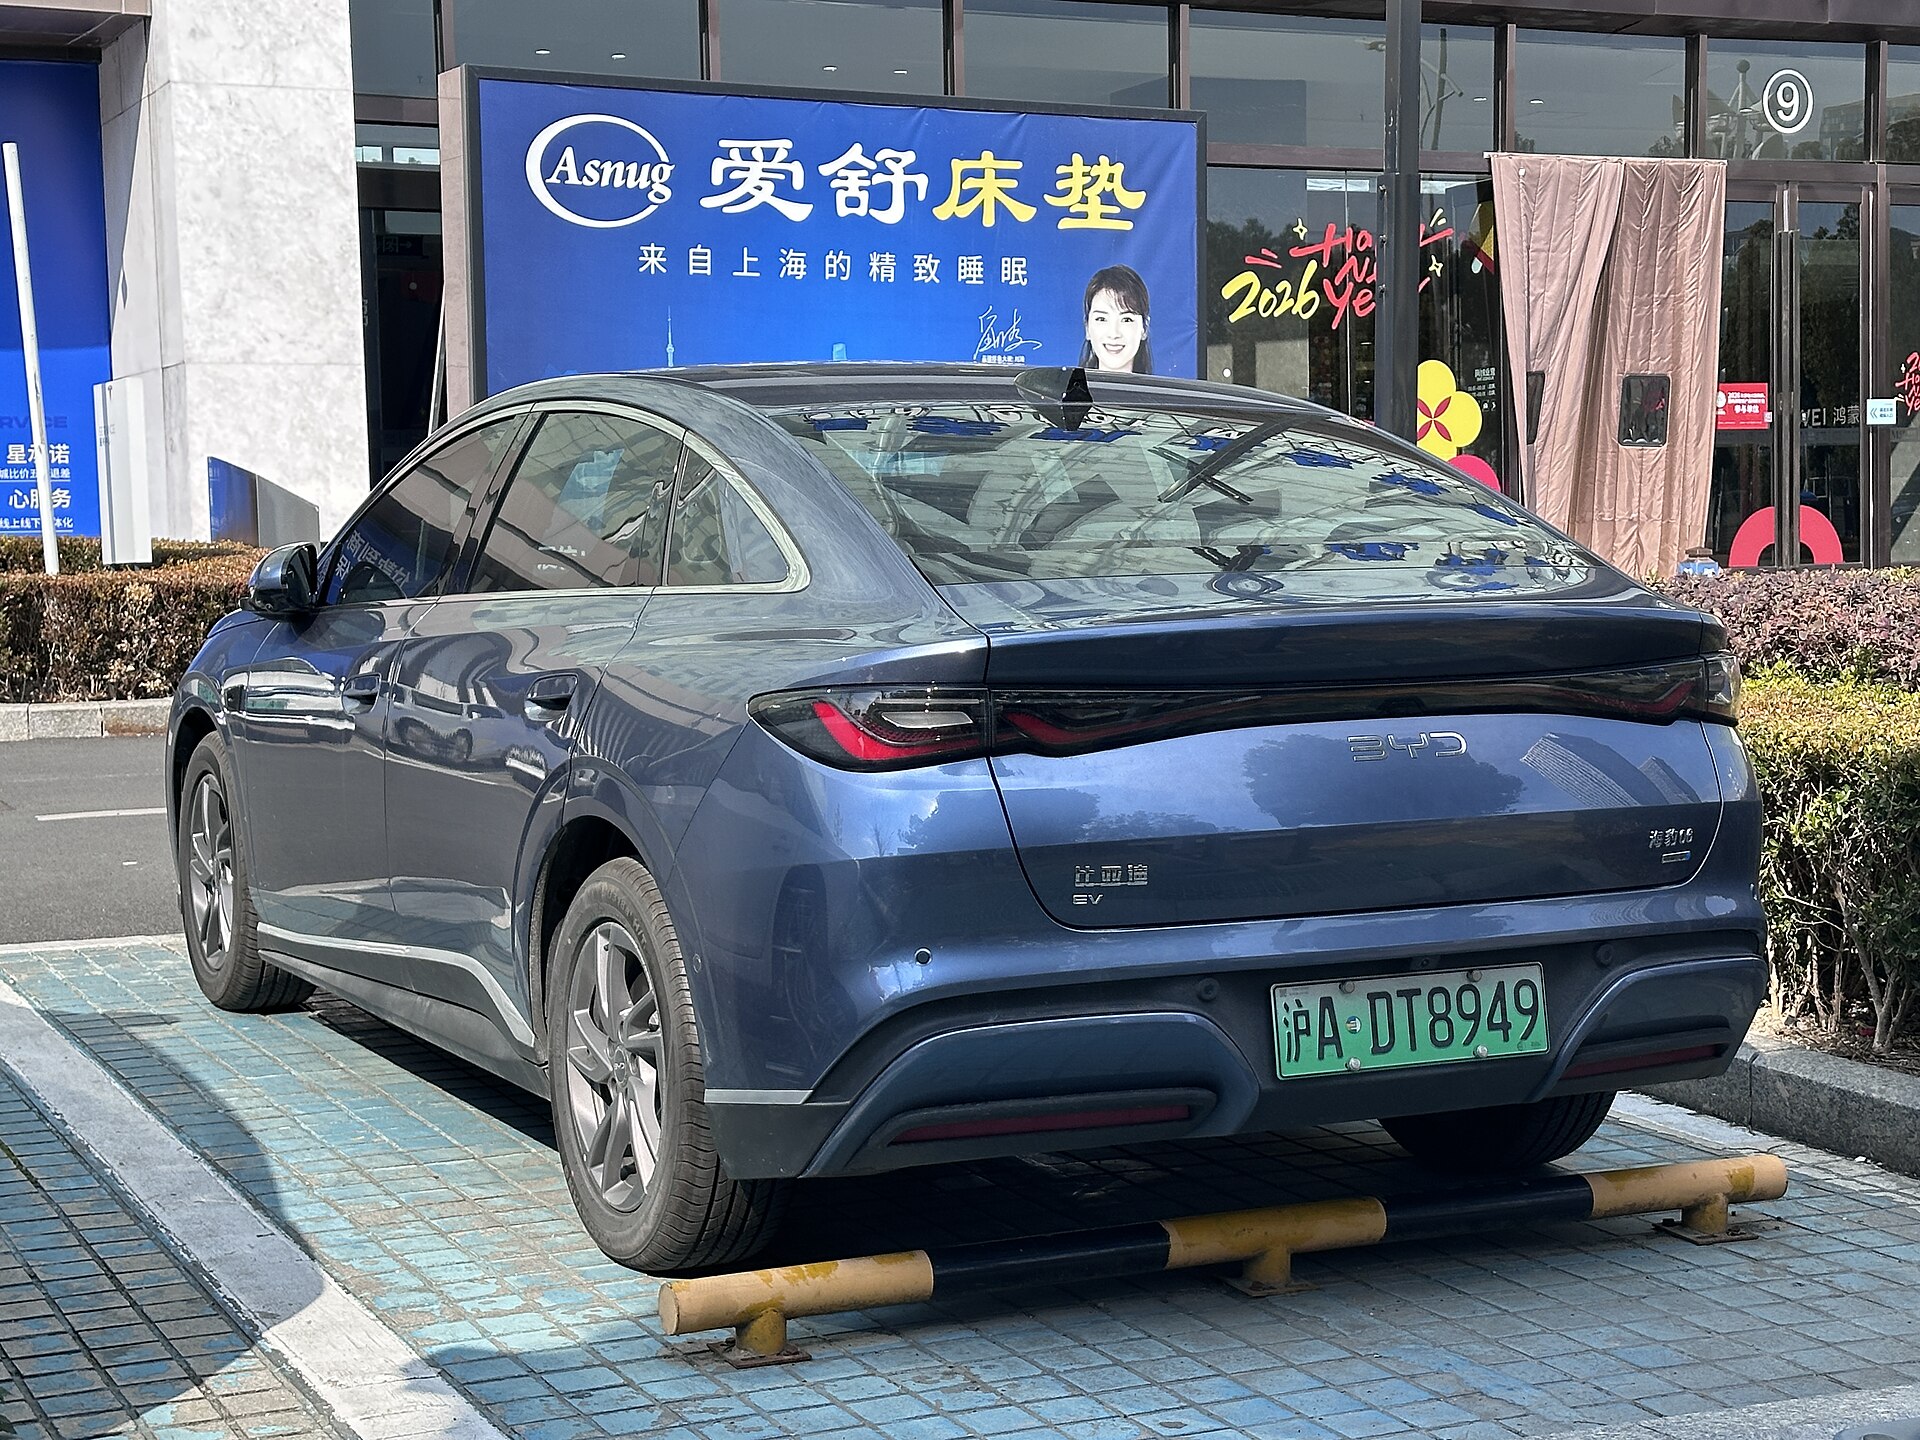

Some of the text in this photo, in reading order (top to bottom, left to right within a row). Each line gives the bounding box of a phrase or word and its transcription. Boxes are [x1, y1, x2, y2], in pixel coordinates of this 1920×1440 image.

[1776, 81, 1800, 121] 9
[545, 146, 675, 204] Asnug
[700, 138, 1147, 231] 爱舒床垫
[637, 243, 1028, 286] 来自上海的精致睡眠
[1221, 259, 1320, 323] 2026
[1833, 405, 1860, 425] 鸿蒙
[0, 516, 73, 528] 线上线下体化
[1347, 731, 1467, 762] BYD
[1075, 864, 1148, 887] 比亚迪
[1072, 894, 1104, 905] EV
